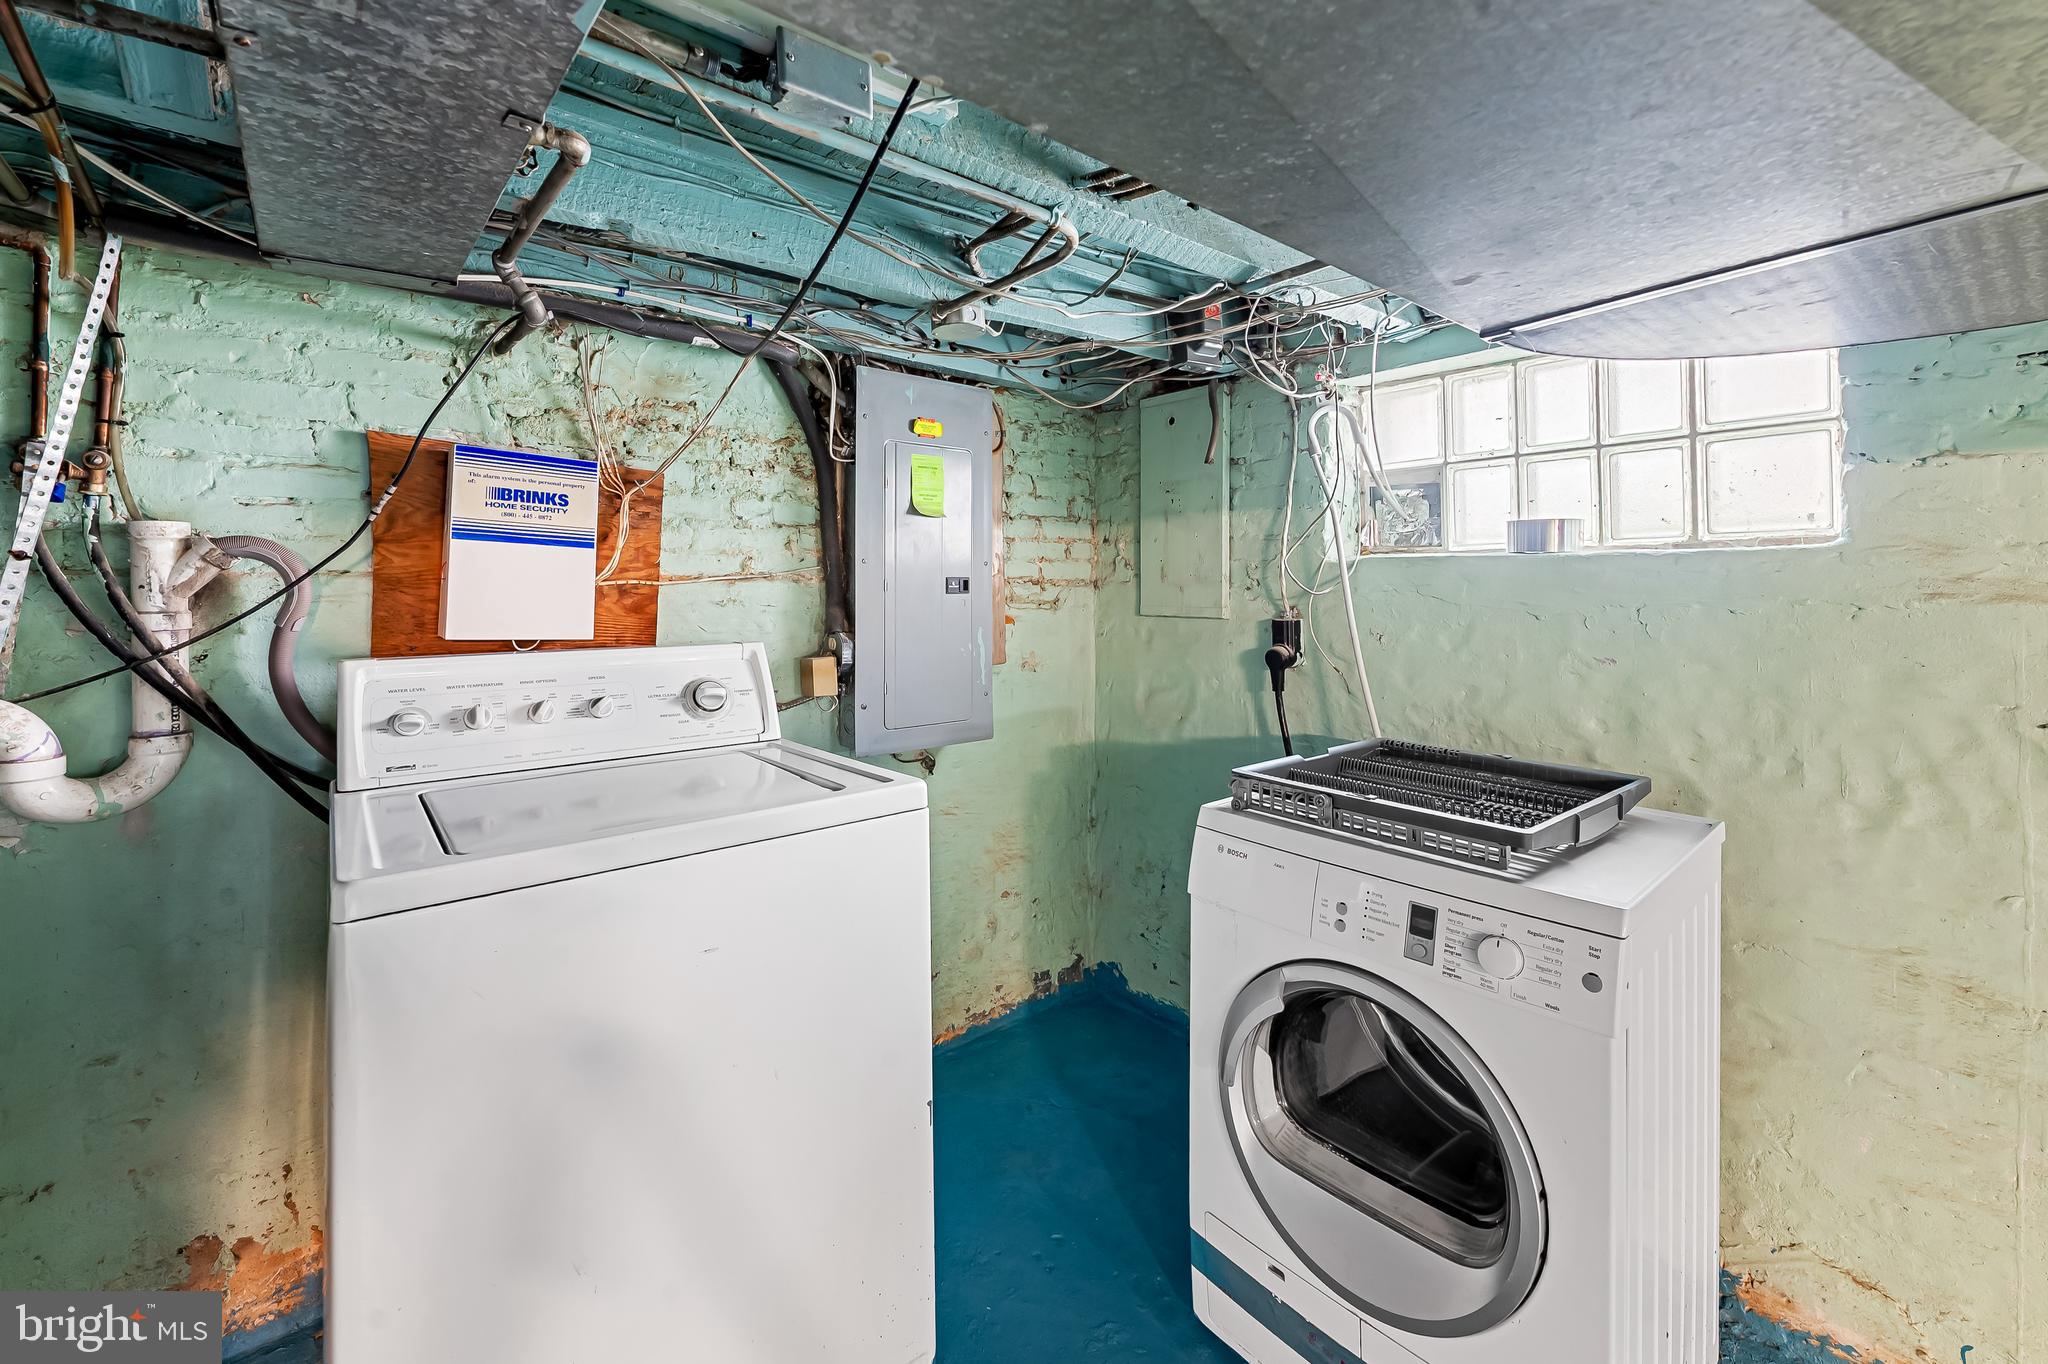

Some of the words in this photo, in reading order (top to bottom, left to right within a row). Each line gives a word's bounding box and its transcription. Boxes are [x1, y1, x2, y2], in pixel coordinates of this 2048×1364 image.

[538, 479, 561, 487] personal
[499, 487, 569, 507] BRINKS
[485, 501, 517, 510] HOME
[520, 504, 568, 514] SECURITY
[1227, 848, 1248, 860] BOSCH
[1448, 908, 1471, 918] Permanent
[1527, 929, 1564, 944] Regular/Cotton
[1588, 952, 1600, 960] Stop
[1442, 964, 1456, 973] Timed
[1536, 964, 1553, 973] Regular
[1539, 976, 1552, 985] Damp
[1545, 1002, 1560, 1012] Wools
